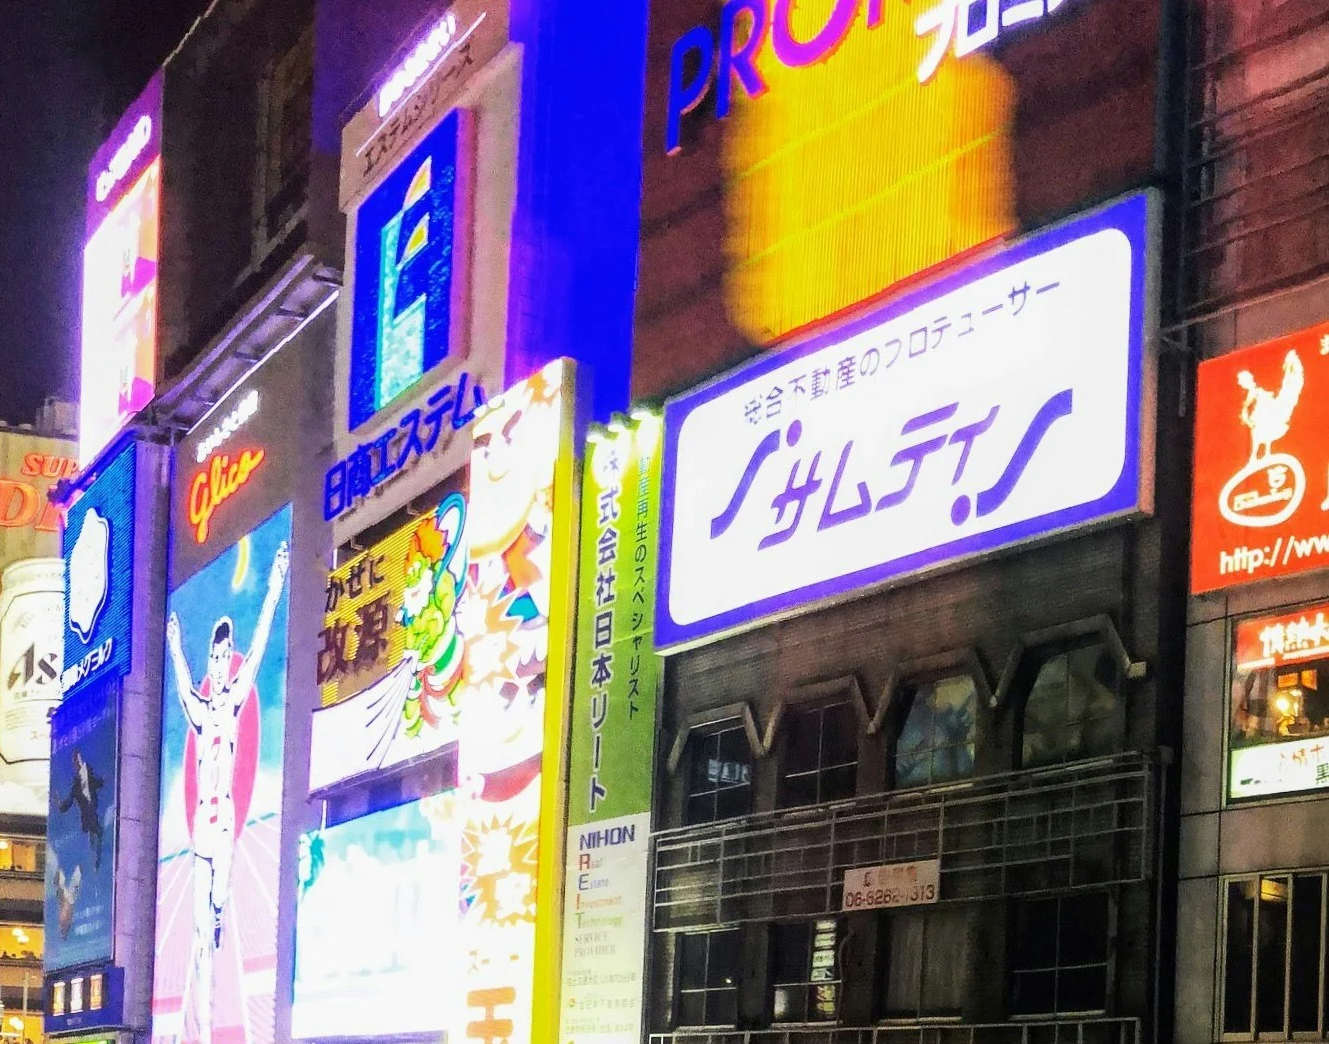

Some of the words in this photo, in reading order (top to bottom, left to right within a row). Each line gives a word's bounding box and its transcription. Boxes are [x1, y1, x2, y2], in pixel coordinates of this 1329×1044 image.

[666, 0, 885, 155] PRO
[21, 452, 80, 478] SUP
[191, 449, 265, 543] Glico
[757, 402, 1001, 552] サムティ
[325, 555, 385, 613] かぜに
[627, 456, 651, 721] 動産再生のスペシャリスト
[7, 642, 58, 690] As
[579, 824, 636, 851] NIHON
